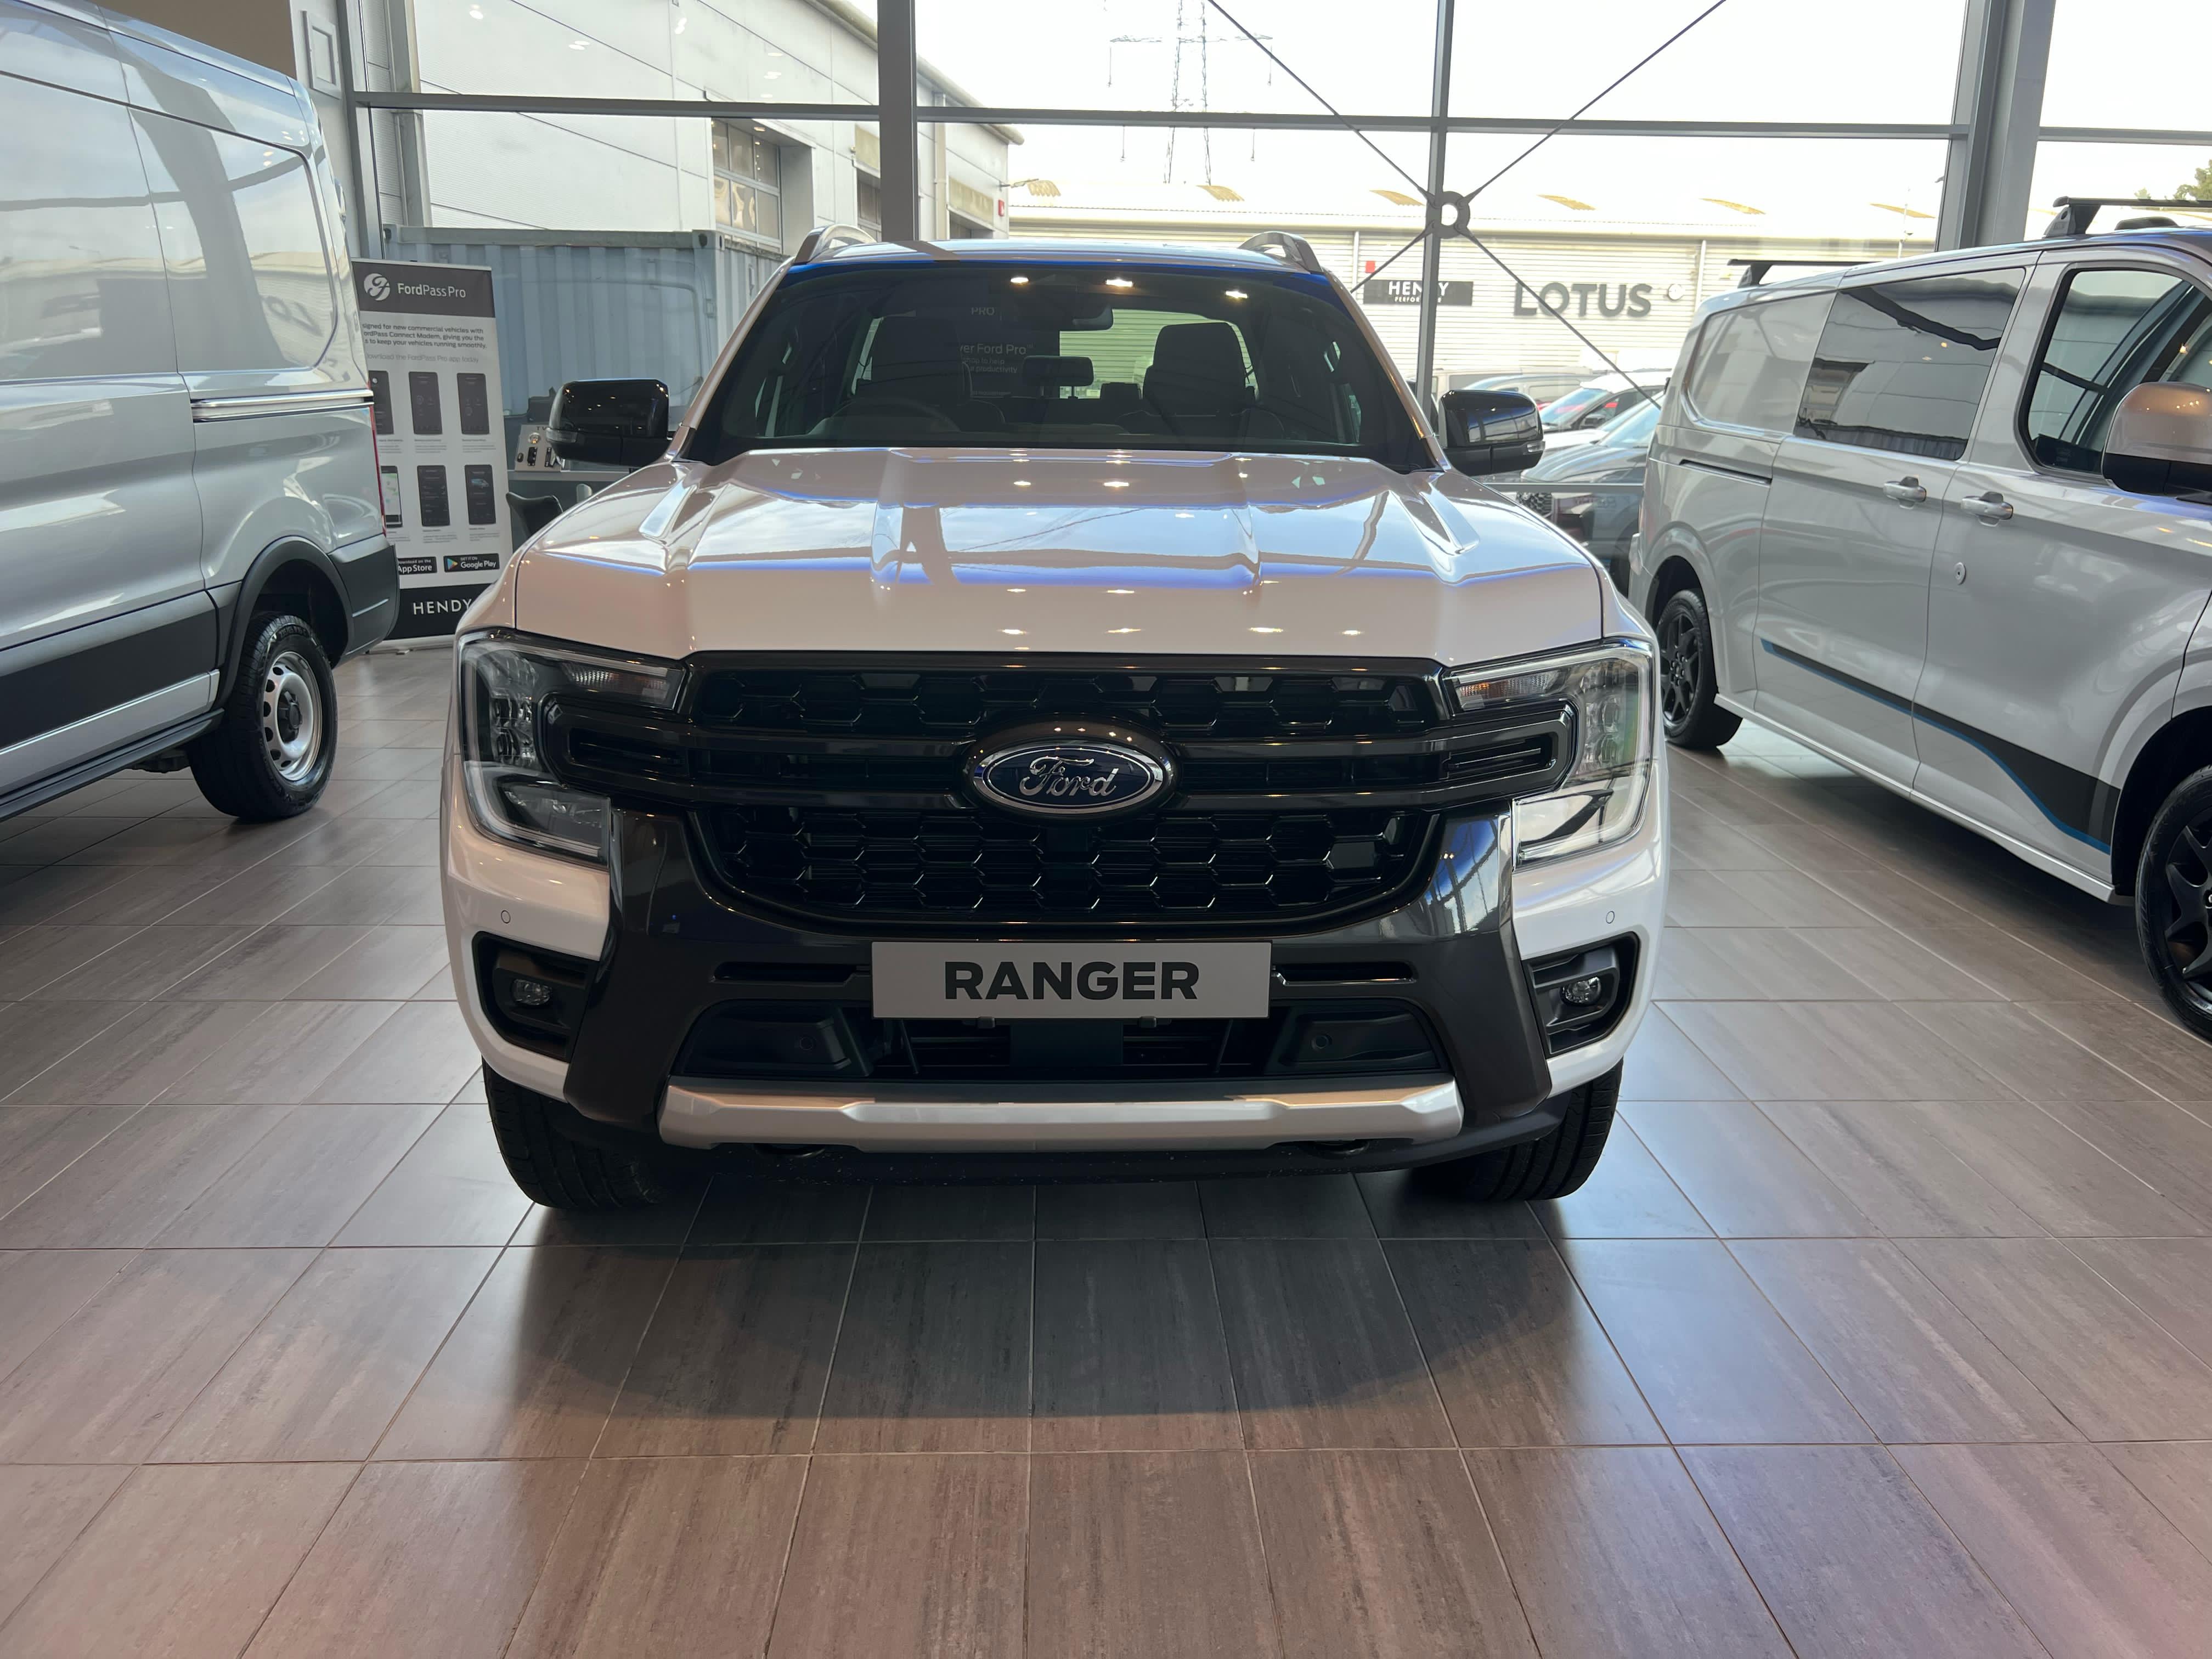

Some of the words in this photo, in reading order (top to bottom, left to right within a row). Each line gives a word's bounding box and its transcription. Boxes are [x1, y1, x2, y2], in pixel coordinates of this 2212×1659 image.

[398, 283, 447, 297] FordPass
[448, 286, 466, 298] Pro
[1389, 281, 1449, 296] HENY
[1514, 281, 1653, 318] LOTUS
[977, 343, 1003, 354] Ford
[398, 566, 412, 574] App
[460, 561, 483, 569] Google
[413, 598, 472, 615] HENDY
[1019, 757, 1119, 796] Ford
[945, 961, 1199, 1000] RANGER
